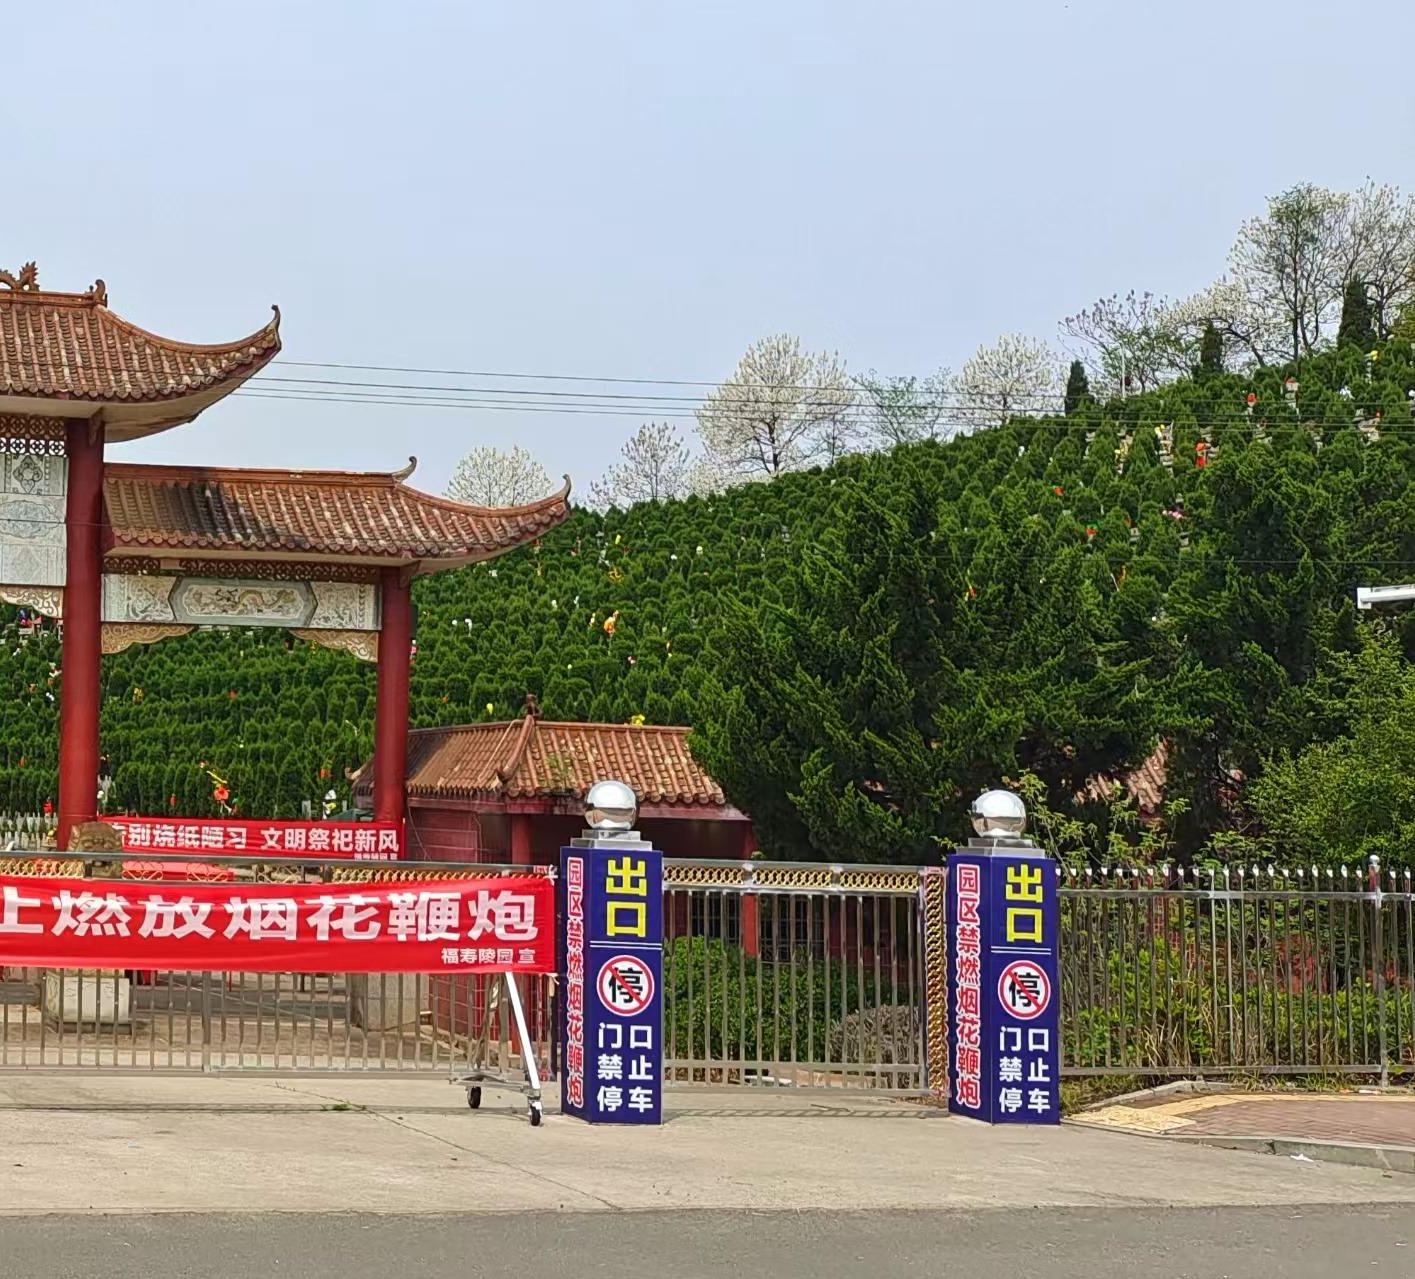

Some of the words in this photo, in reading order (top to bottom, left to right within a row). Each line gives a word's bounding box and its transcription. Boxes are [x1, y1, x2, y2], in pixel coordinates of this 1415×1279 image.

[260, 827, 399, 852] 文明祭祀新风
[606, 857, 647, 937] 出口
[1006, 864, 1043, 943] 出口
[441, 948, 513, 965] 福寿陵园
[518, 949, 536, 964] 宣
[567, 857, 583, 1108] 园区禁燃烟花鞭炮
[608, 967, 643, 1003] 停
[957, 864, 980, 1108] 园区禁燃烟花鞭炮
[1009, 972, 1040, 1007] 停
[598, 1022, 653, 1049] 门口
[1000, 1026, 1049, 1052] 门口
[598, 1054, 653, 1080] 禁止
[999, 1057, 1050, 1082] 禁止
[597, 1086, 653, 1113] 停车
[999, 1087, 1050, 1113] 停车
